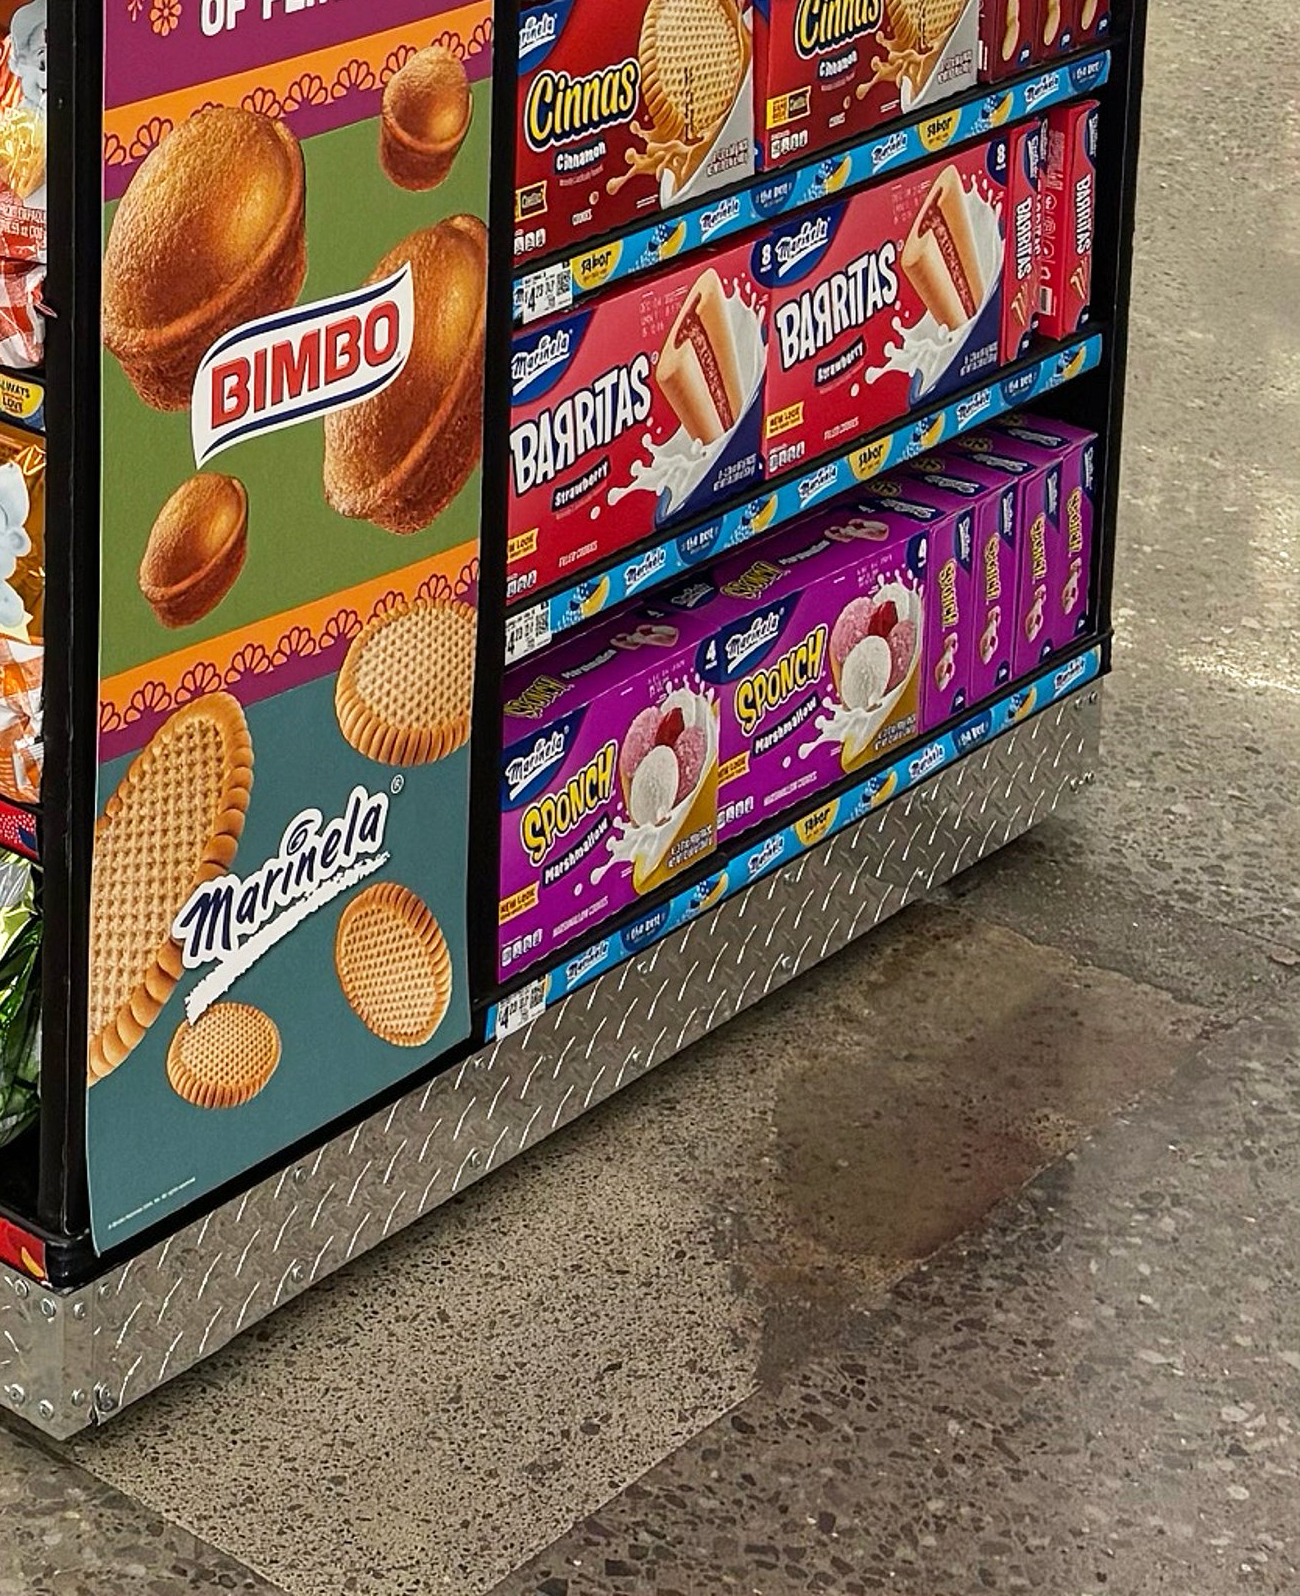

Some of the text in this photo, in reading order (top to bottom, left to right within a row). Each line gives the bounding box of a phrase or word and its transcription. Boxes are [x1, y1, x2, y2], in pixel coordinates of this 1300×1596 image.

[529, 64, 635, 142] Cinnas
[556, 143, 606, 171] Cinnamon
[762, 245, 771, 264] 8
[775, 243, 898, 368] BARRITAS
[211, 302, 400, 427] BIMBO
[512, 331, 569, 378] Marinela
[510, 356, 650, 494] BARRITAS
[555, 462, 609, 506] Strawberry
[707, 641, 716, 661] 4
[738, 631, 826, 728] SPONCH
[755, 697, 816, 753] Marshmallow
[523, 744, 615, 860] SPONCH
[180, 798, 382, 958] Marinela
[544, 818, 608, 885] Marshmallow
